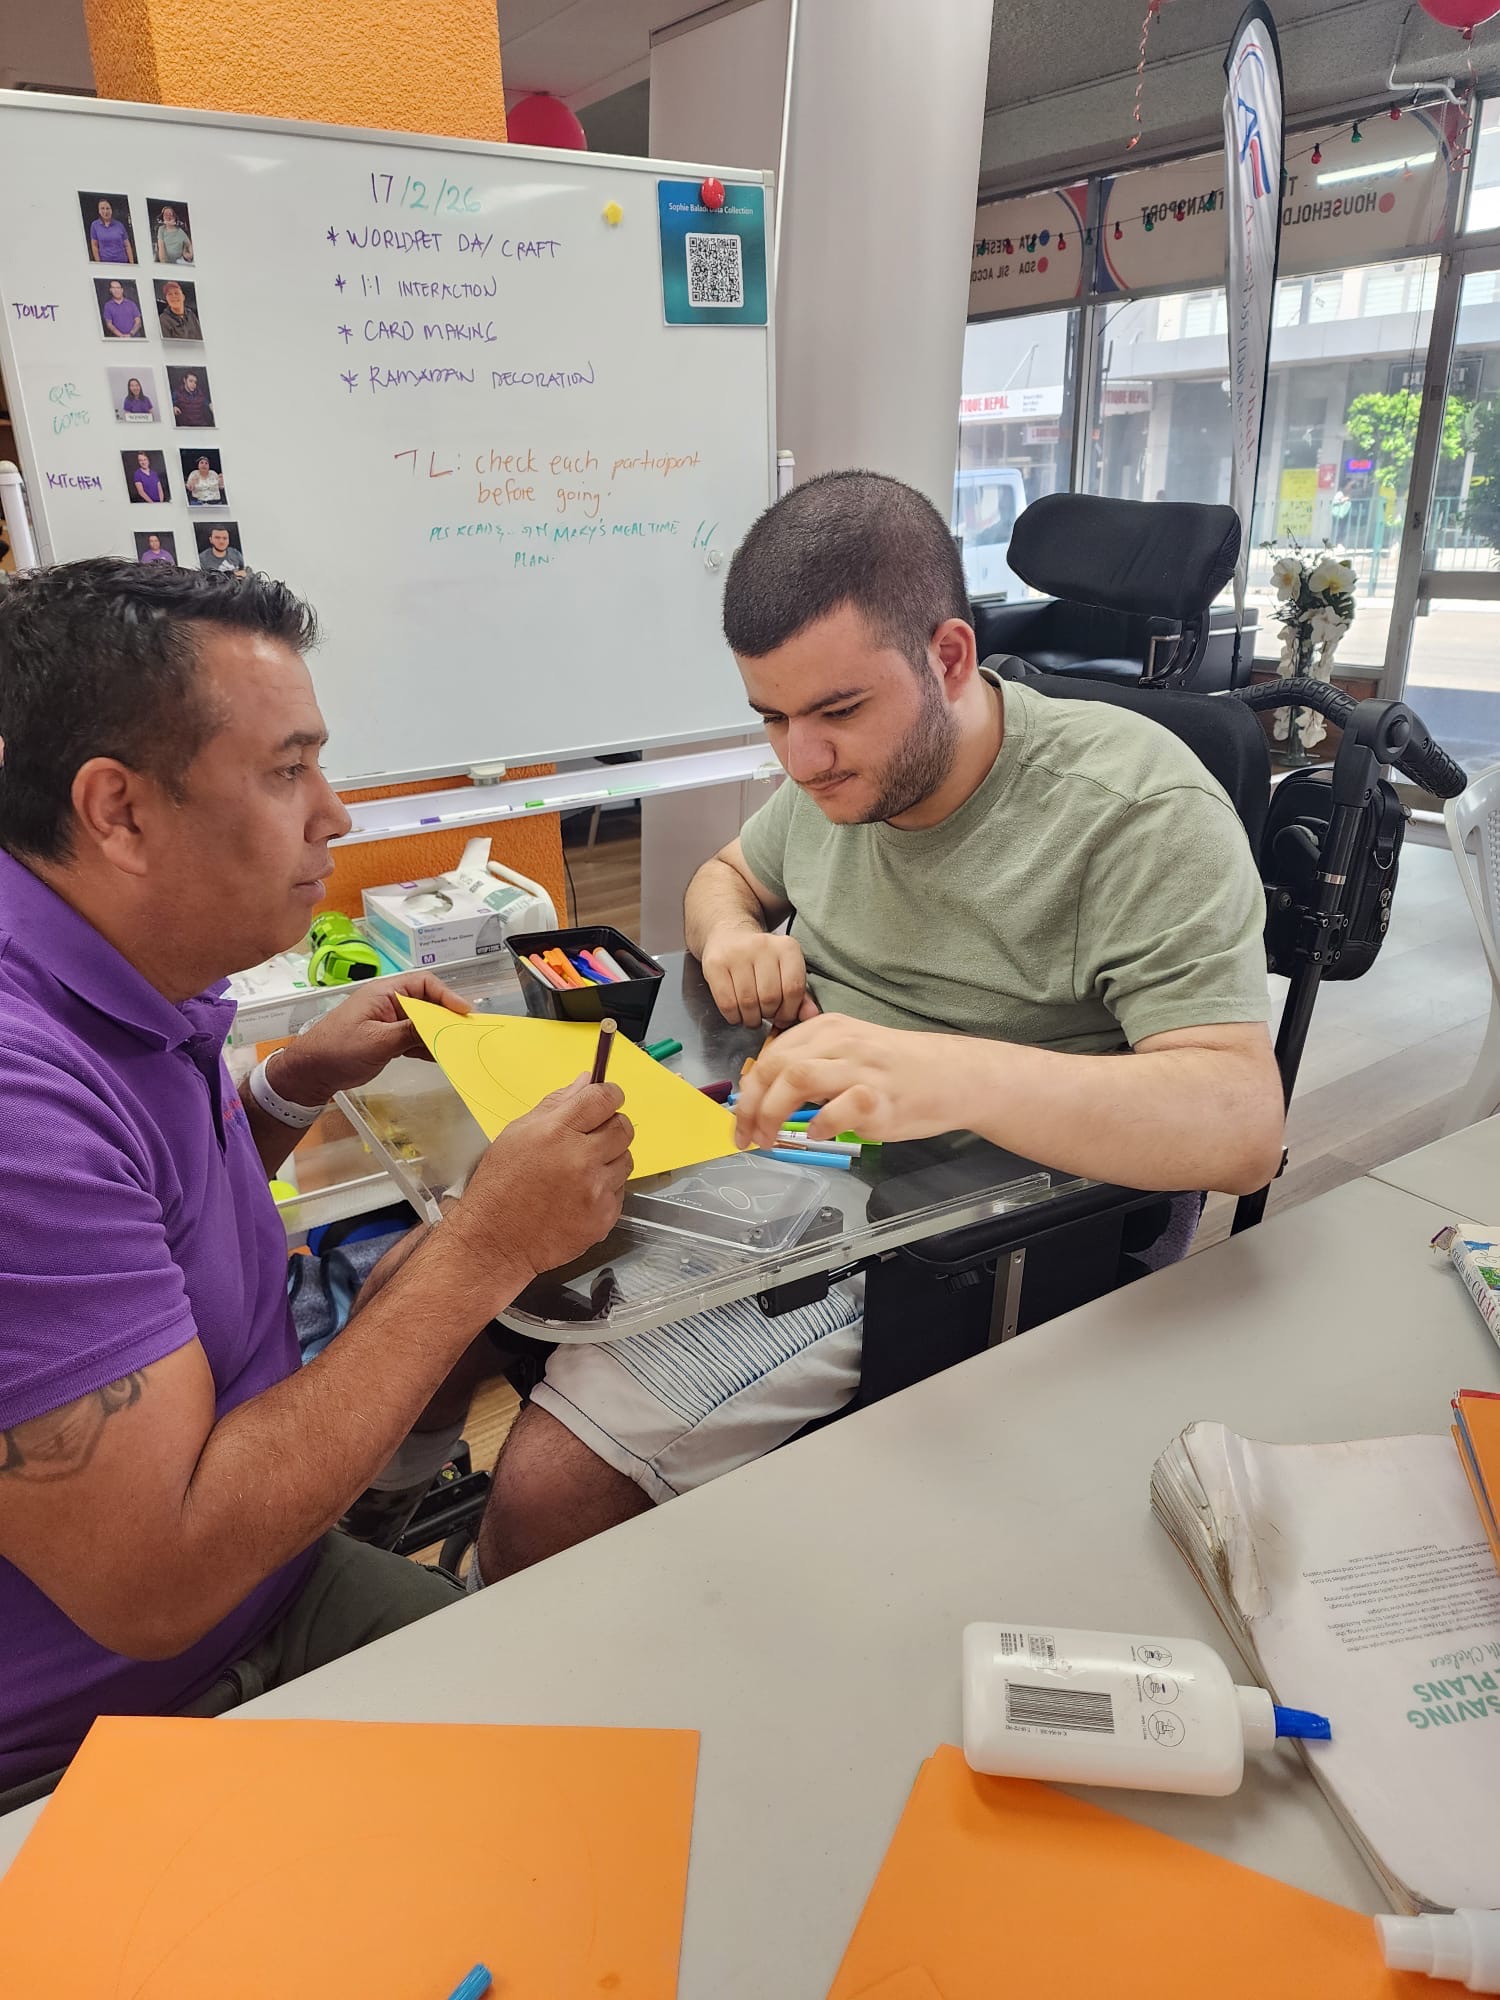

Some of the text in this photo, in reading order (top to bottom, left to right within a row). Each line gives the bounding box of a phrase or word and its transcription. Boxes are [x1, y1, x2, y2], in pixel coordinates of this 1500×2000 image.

[371, 172, 481, 216] 17/2/26
[668, 203, 689, 212] Sophie
[724, 206, 754, 215] Collection
[502, 239, 561, 261] CRAFT
[398, 275, 497, 300] INTERACTION
[12, 302, 59, 322] TOILET
[364, 319, 498, 343] CARD MAKING
[492, 360, 595, 389] DECORATION
[475, 448, 539, 474] check
[550, 449, 599, 476] each
[477, 479, 535, 506] before
[1430, 1646, 1484, 1669] Chelsea
[1413, 1672, 1499, 1702] PLANS
[1407, 1695, 1500, 1729] SAVING
